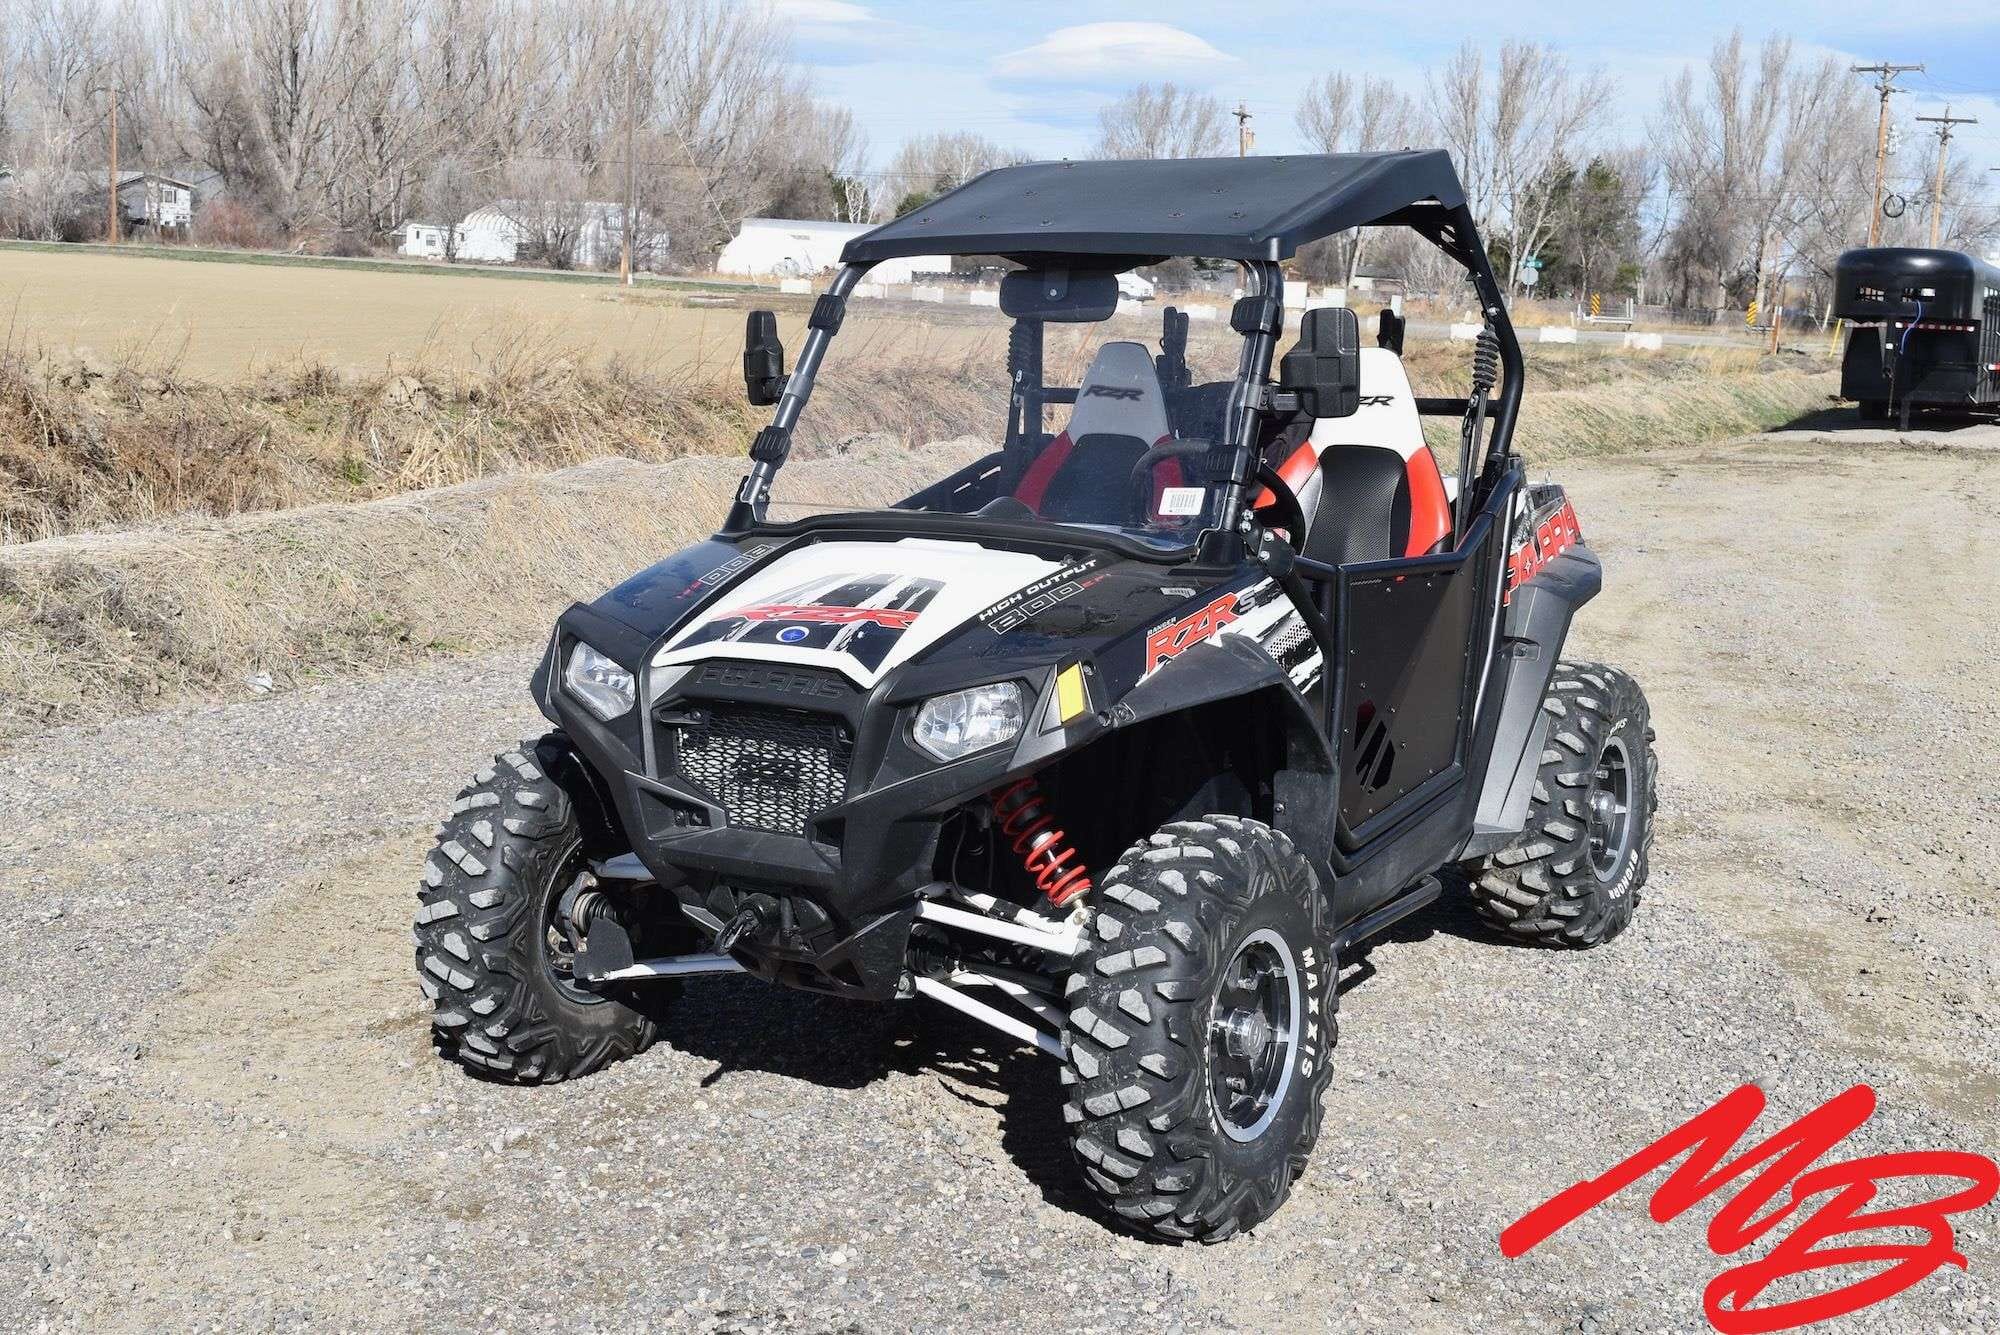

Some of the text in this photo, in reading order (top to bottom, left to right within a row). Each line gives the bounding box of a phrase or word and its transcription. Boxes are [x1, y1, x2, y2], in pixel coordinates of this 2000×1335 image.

[1083, 384, 1144, 401] RZR
[1359, 396, 1395, 406] ZR
[979, 559, 1097, 621] HIGH OUTPUT
[987, 580, 1085, 635] 800
[1146, 592, 1241, 675] RZR
[696, 664, 847, 699] POLARIS
[1301, 946, 1320, 1079] MAXXIS
